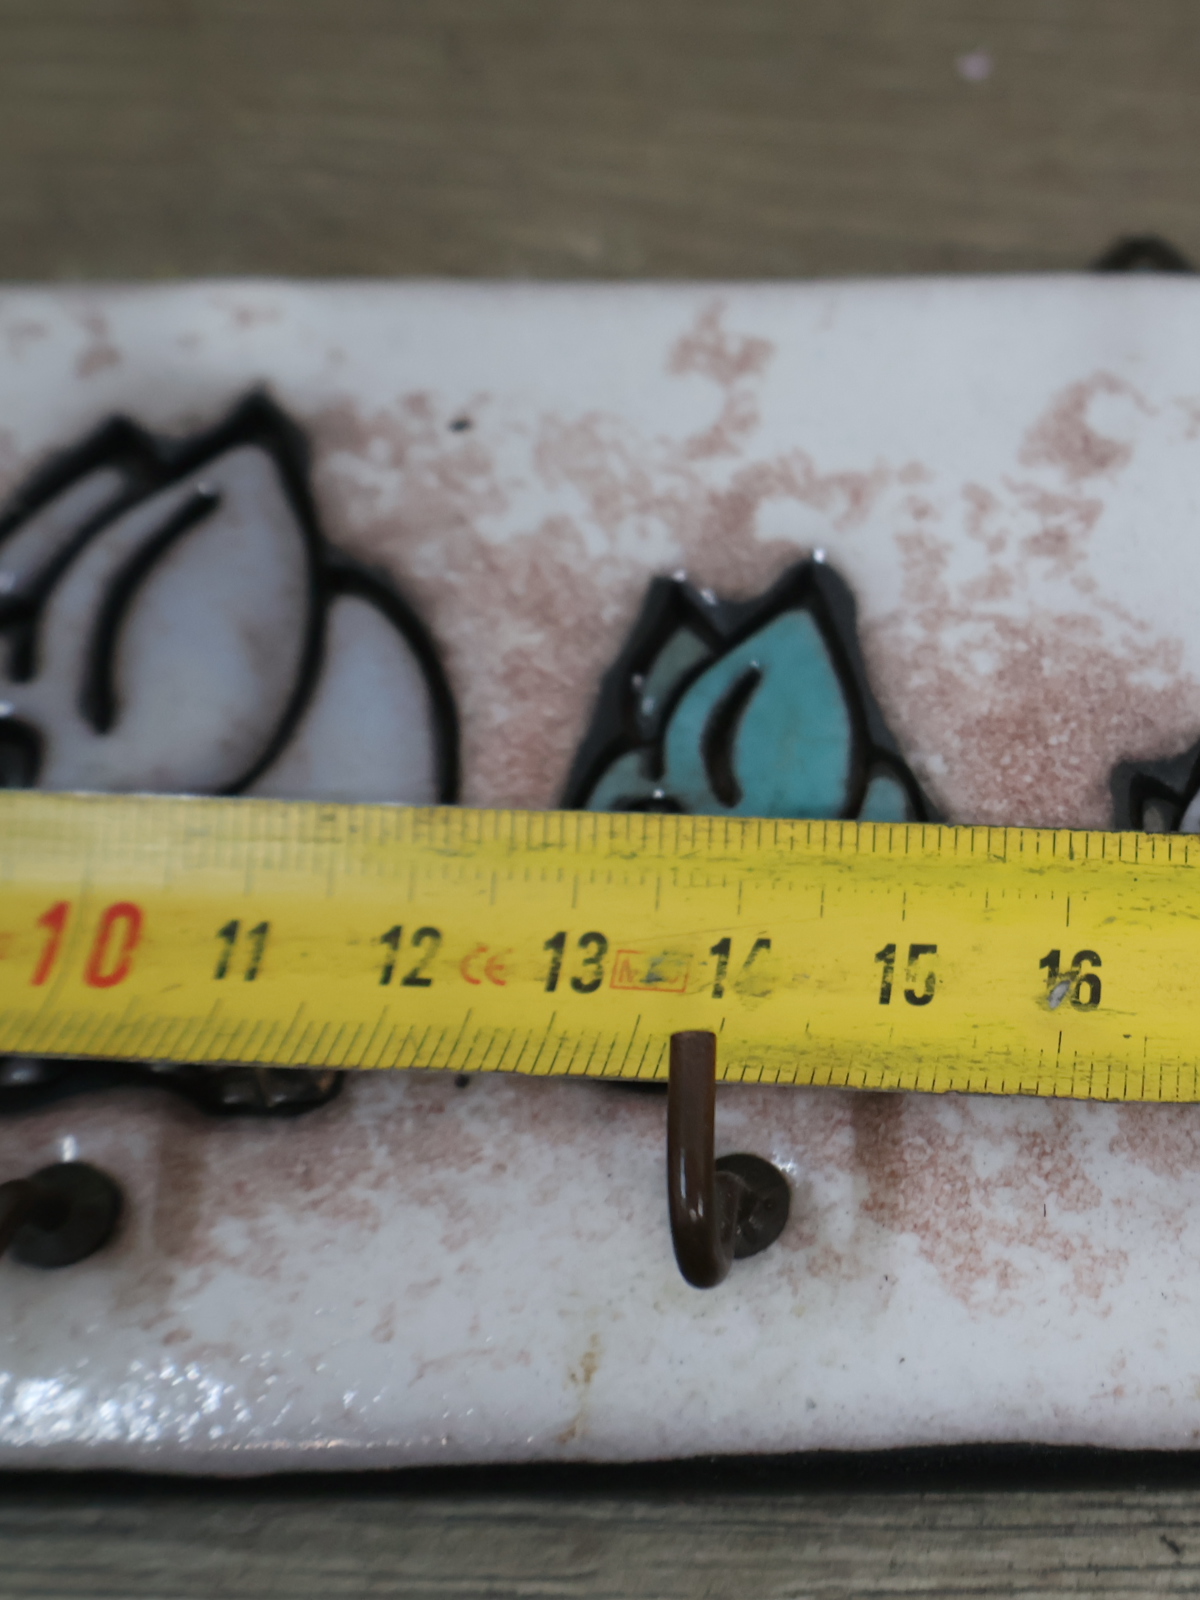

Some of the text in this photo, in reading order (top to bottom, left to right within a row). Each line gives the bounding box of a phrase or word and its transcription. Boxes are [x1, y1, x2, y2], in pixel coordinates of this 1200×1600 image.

[29, 900, 143, 988] 10
[213, 919, 271, 981] 11
[379, 924, 443, 987] 12
[543, 931, 609, 993] 13
[875, 943, 937, 1006] 15
[1039, 949, 1102, 1011] 16
